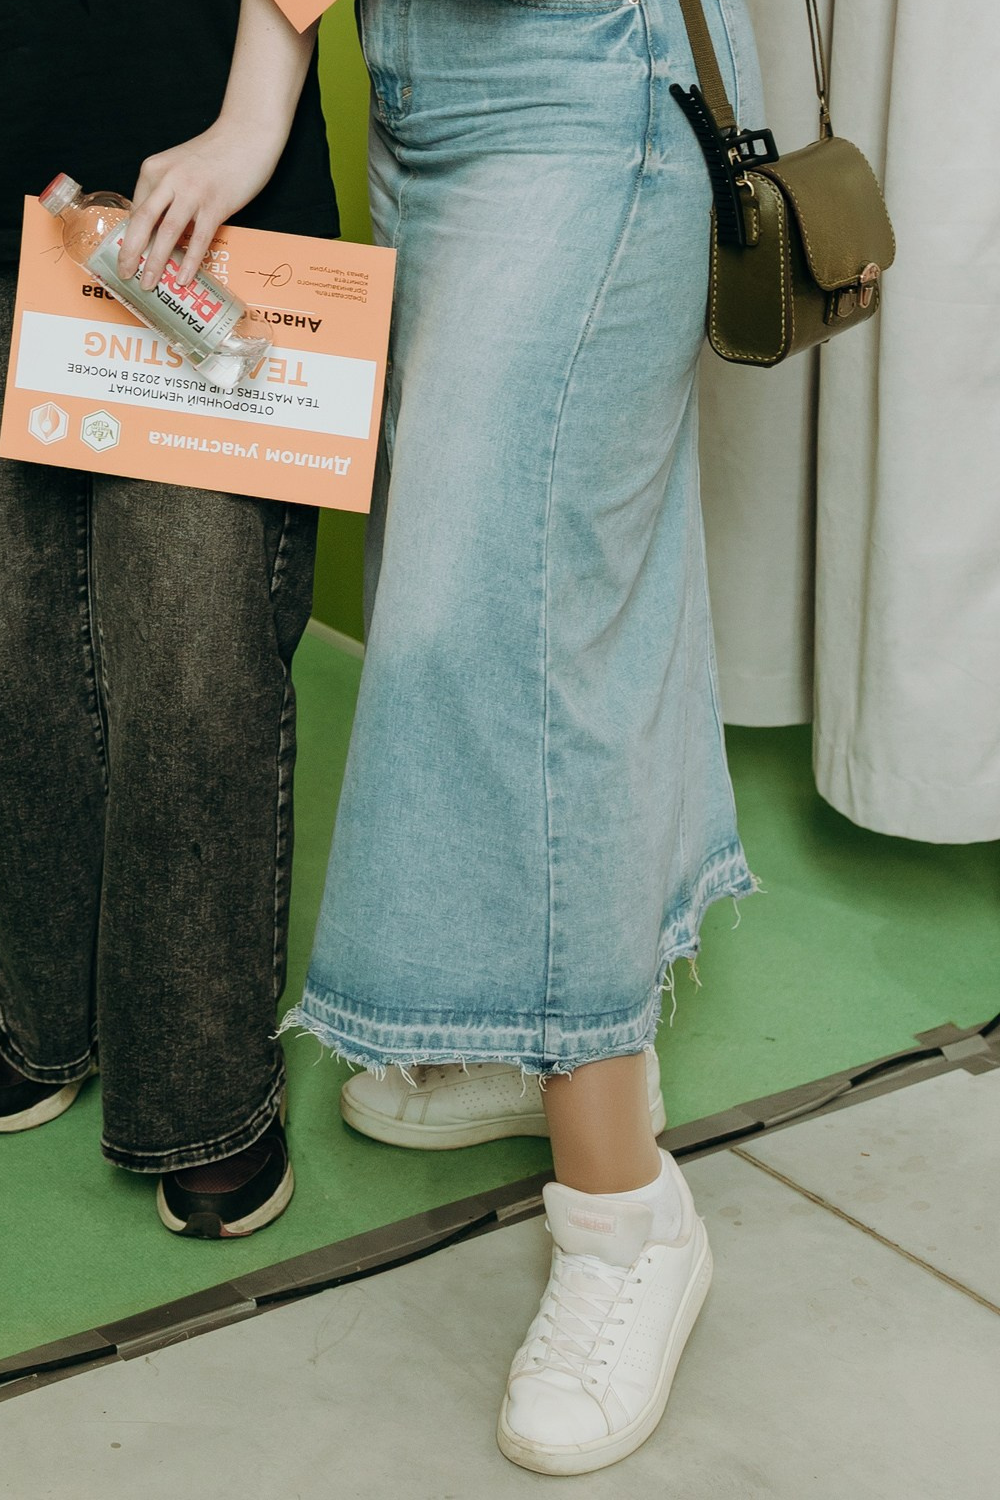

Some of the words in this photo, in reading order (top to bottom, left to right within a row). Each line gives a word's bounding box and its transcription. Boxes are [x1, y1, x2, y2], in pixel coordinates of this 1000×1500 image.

[309, 266, 348, 276] Чантурия
[348, 271, 368, 280] Рамаз
[296, 279, 367, 295] Организационного
[333, 277, 368, 285] комитета
[315, 290, 366, 303] Председатель
[85, 332, 184, 367] STING
[67, 362, 117, 378] МОСКВЕ
[132, 372, 160, 384] 2025
[164, 377, 206, 391] RUSSIA
[108, 384, 183, 401] ЧЕМПИОНАТ
[236, 386, 292, 403] MASTERS
[187, 395, 273, 415] ОТБОРОЧНЫЙ
[296, 396, 319, 408] TEA
[148, 431, 257, 458] участника
[265, 448, 350, 475] Диплом
